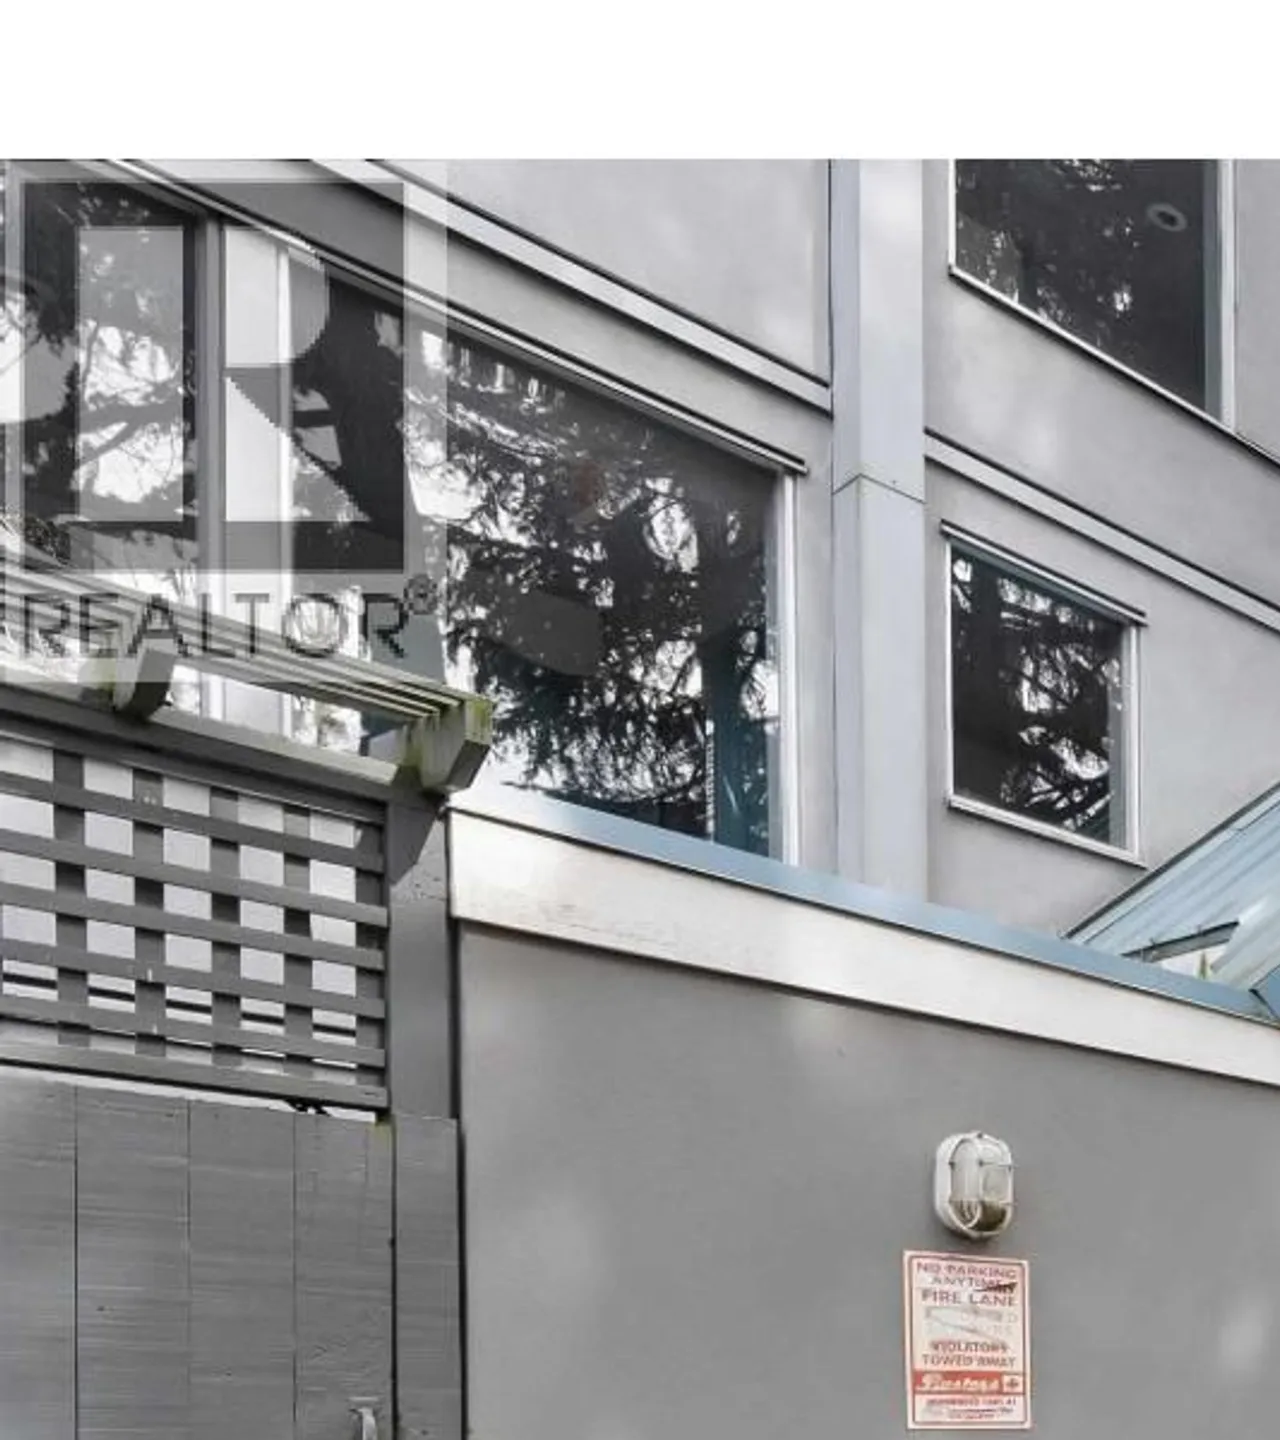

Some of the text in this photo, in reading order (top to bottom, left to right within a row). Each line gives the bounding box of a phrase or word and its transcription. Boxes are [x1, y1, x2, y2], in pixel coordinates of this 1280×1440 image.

[917, 1262, 1017, 1280] NO PARKING
[922, 1288, 1017, 1307] FIRE LANE
[922, 1354, 1016, 1368] TOWED AWAY
